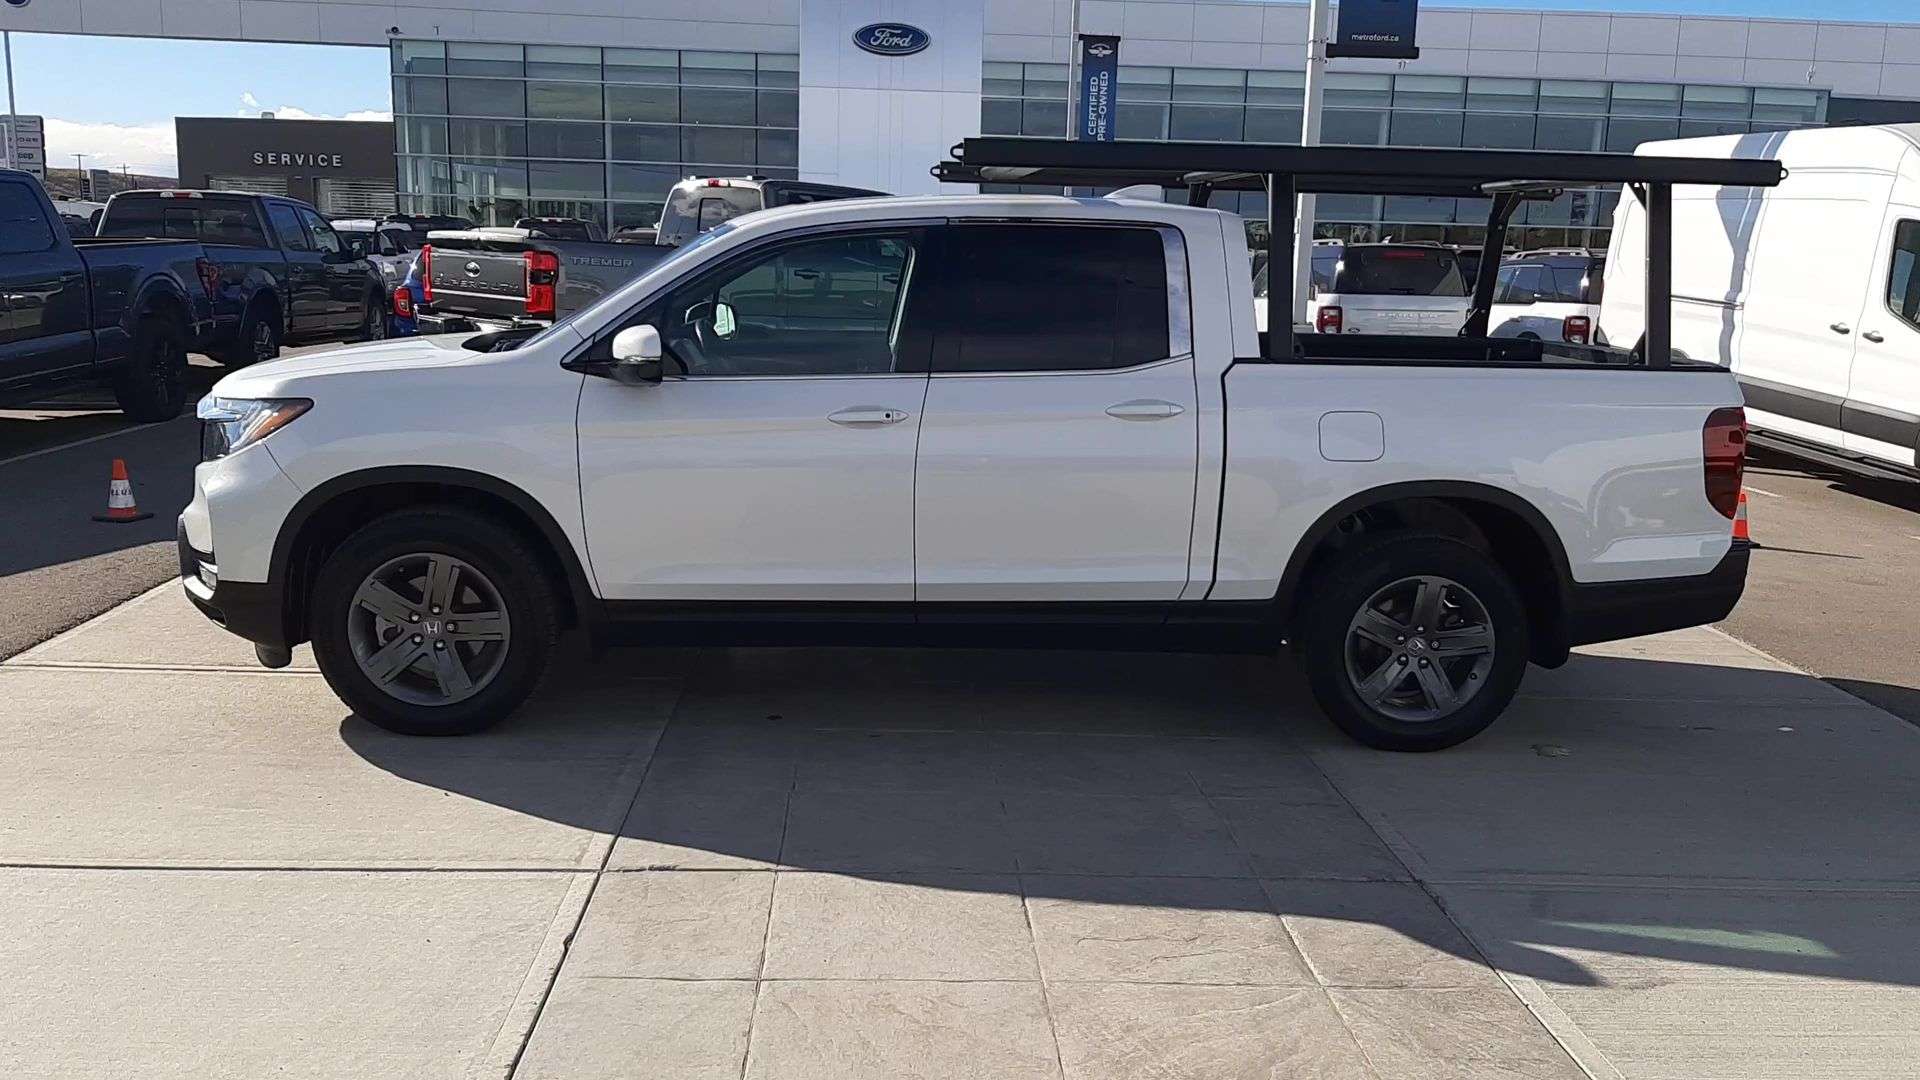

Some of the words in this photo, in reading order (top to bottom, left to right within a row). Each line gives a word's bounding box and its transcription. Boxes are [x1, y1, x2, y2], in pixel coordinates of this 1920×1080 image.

[870, 28, 913, 47] Ford
[1088, 76, 1099, 135] CERTIFIED
[1097, 71, 1109, 141] PRE-OWNED
[253, 152, 342, 167] SERVICE
[571, 256, 633, 267] TREMOR
